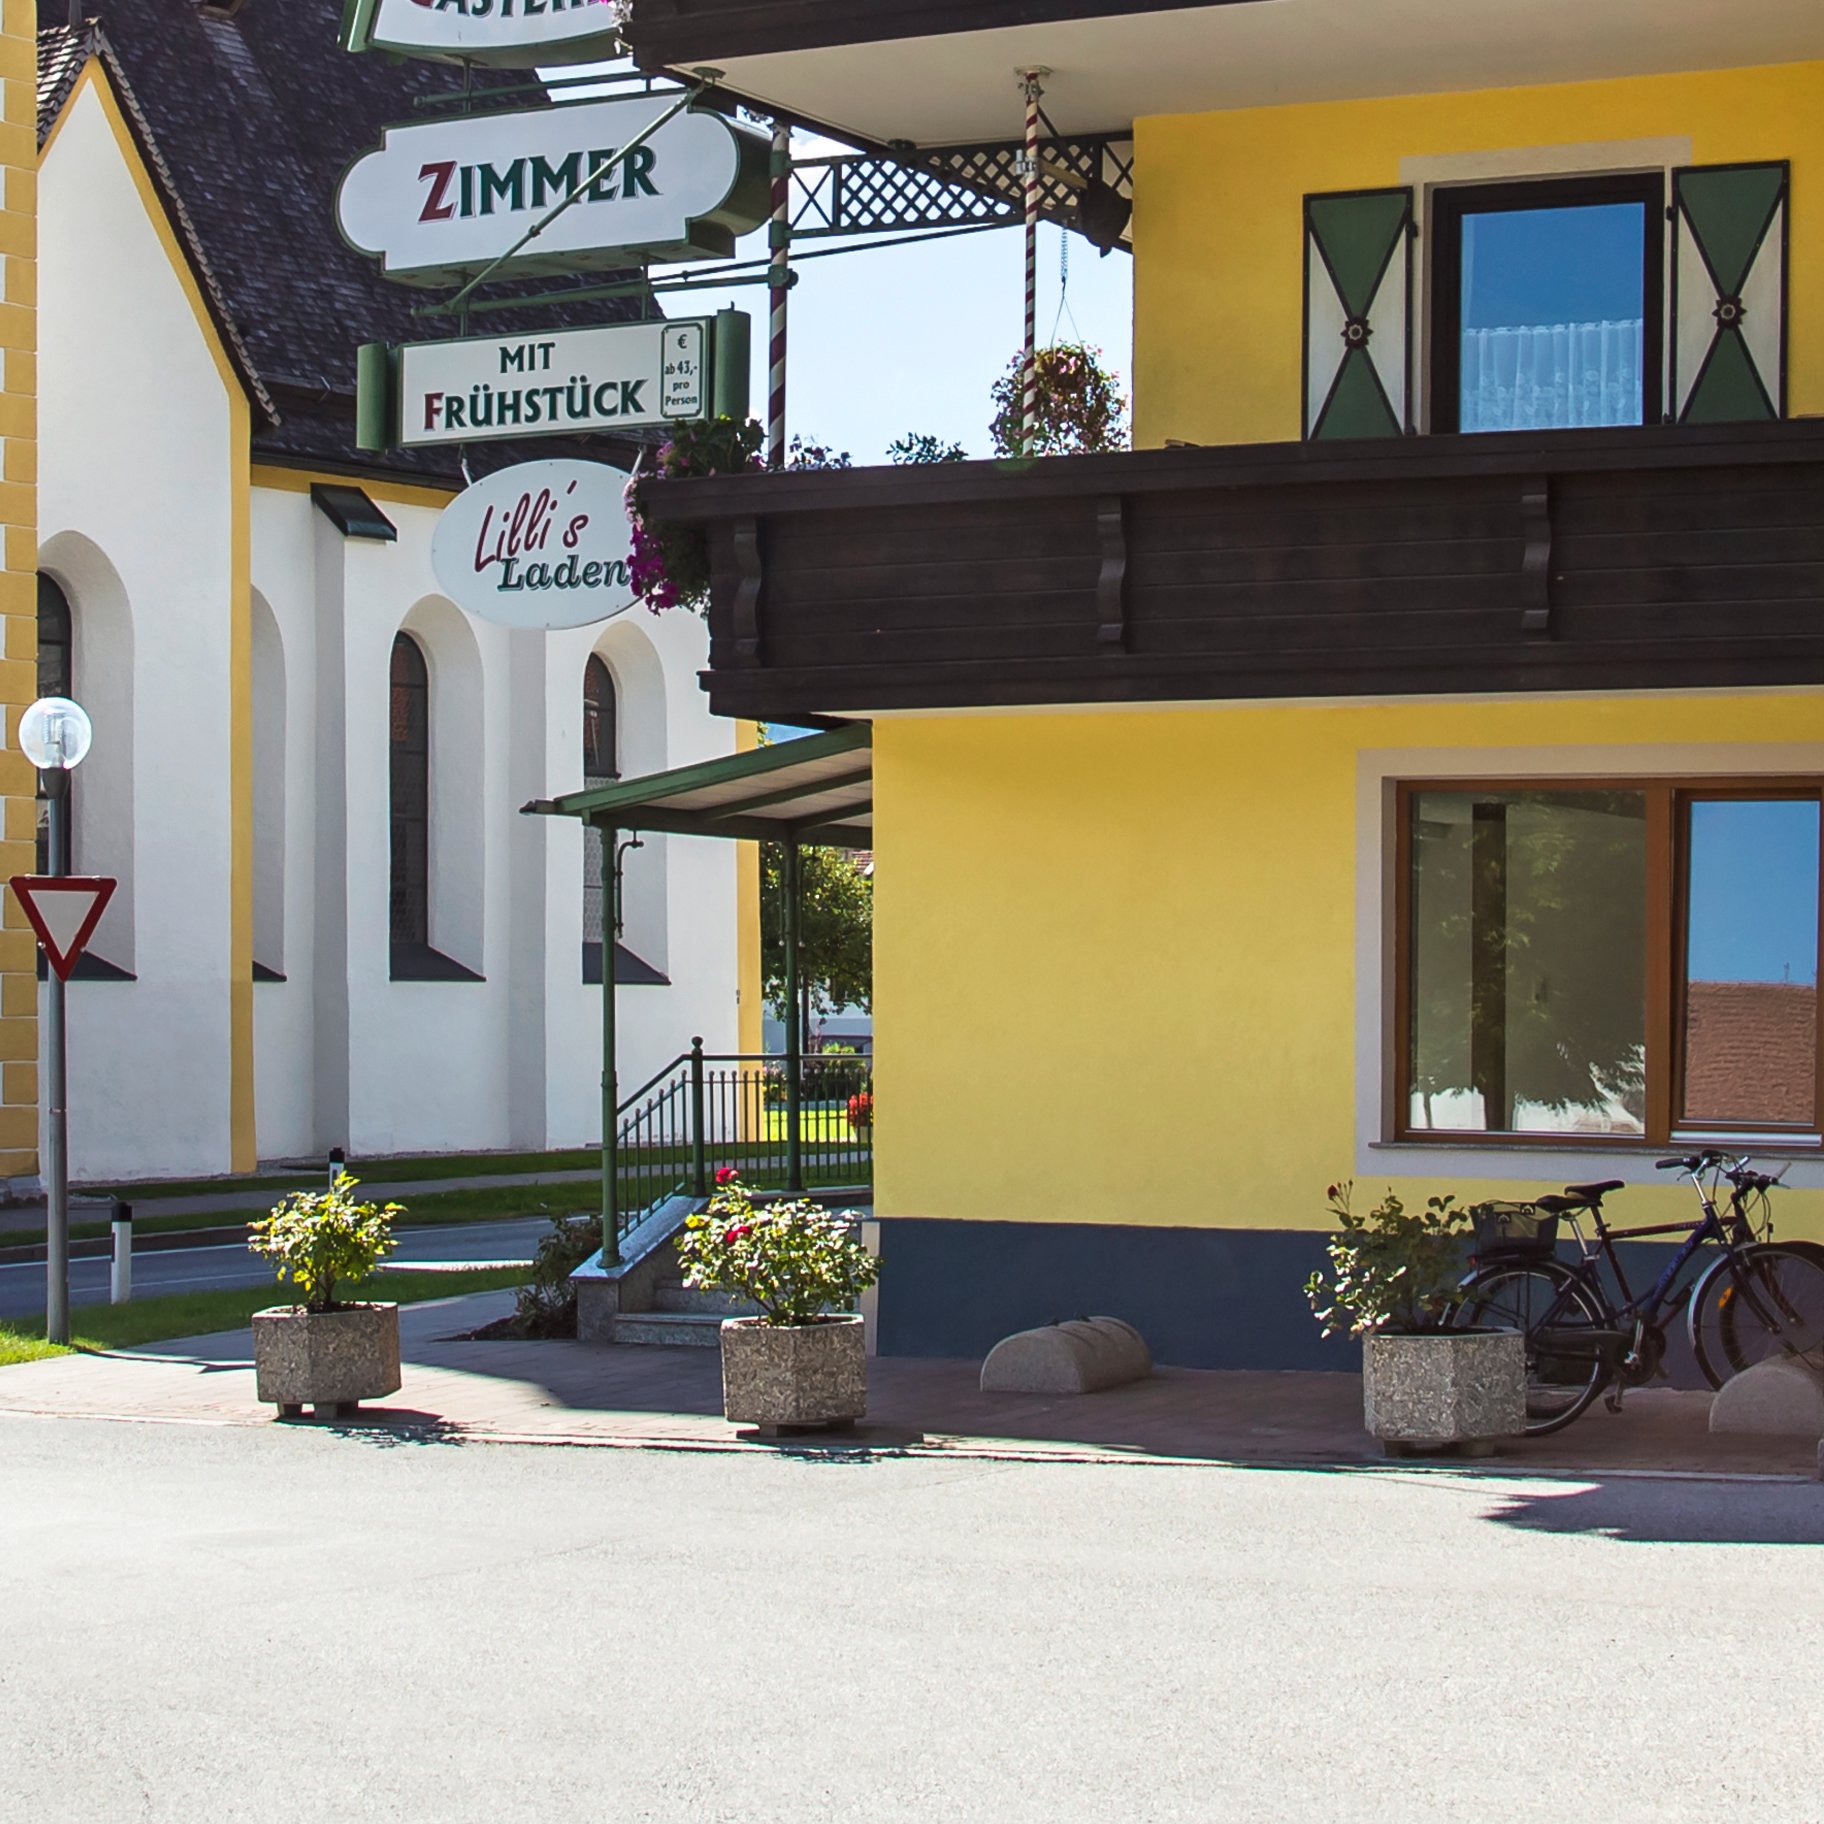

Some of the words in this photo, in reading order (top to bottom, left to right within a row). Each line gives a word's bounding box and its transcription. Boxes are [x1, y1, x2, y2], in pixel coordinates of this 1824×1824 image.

[417, 144, 664, 225] ZIMMER
[498, 341, 556, 374] MIT
[664, 362, 676, 375] ab
[423, 374, 649, 432] FRÜHSTÜCK
[664, 395, 698, 407] Person
[672, 380, 690, 393] pro
[496, 554, 631, 593] Laden
